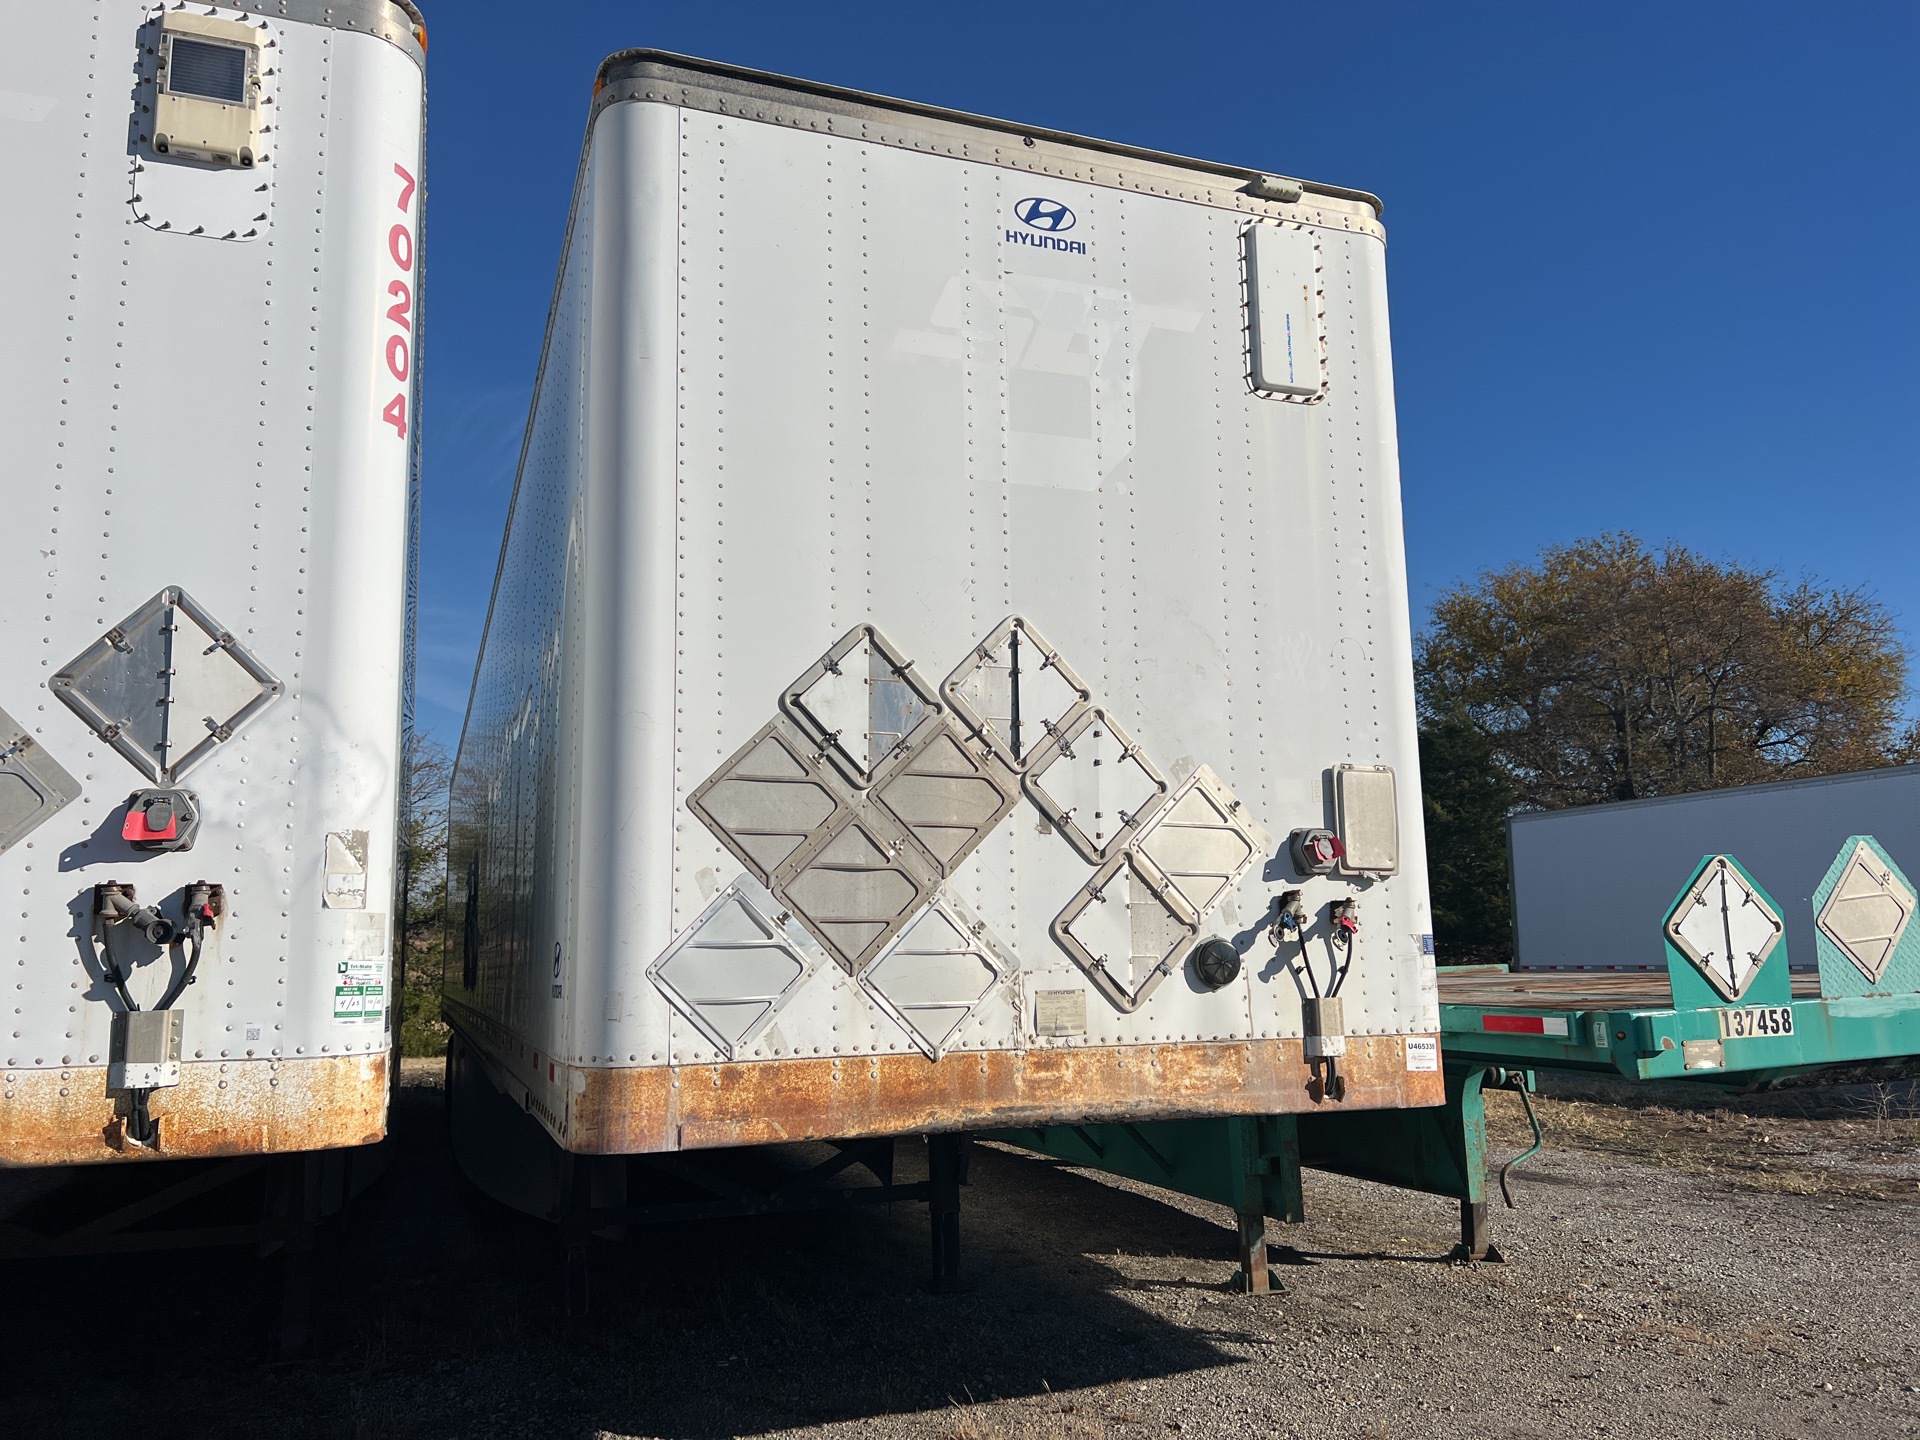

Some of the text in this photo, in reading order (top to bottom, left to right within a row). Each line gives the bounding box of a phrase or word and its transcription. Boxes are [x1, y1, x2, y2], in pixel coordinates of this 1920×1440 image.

[1005, 229, 1086, 255] HYUNDAI
[383, 162, 415, 440] 70204
[1722, 1008, 1792, 1037] 137458
[1408, 1042, 1435, 1050] U465338
